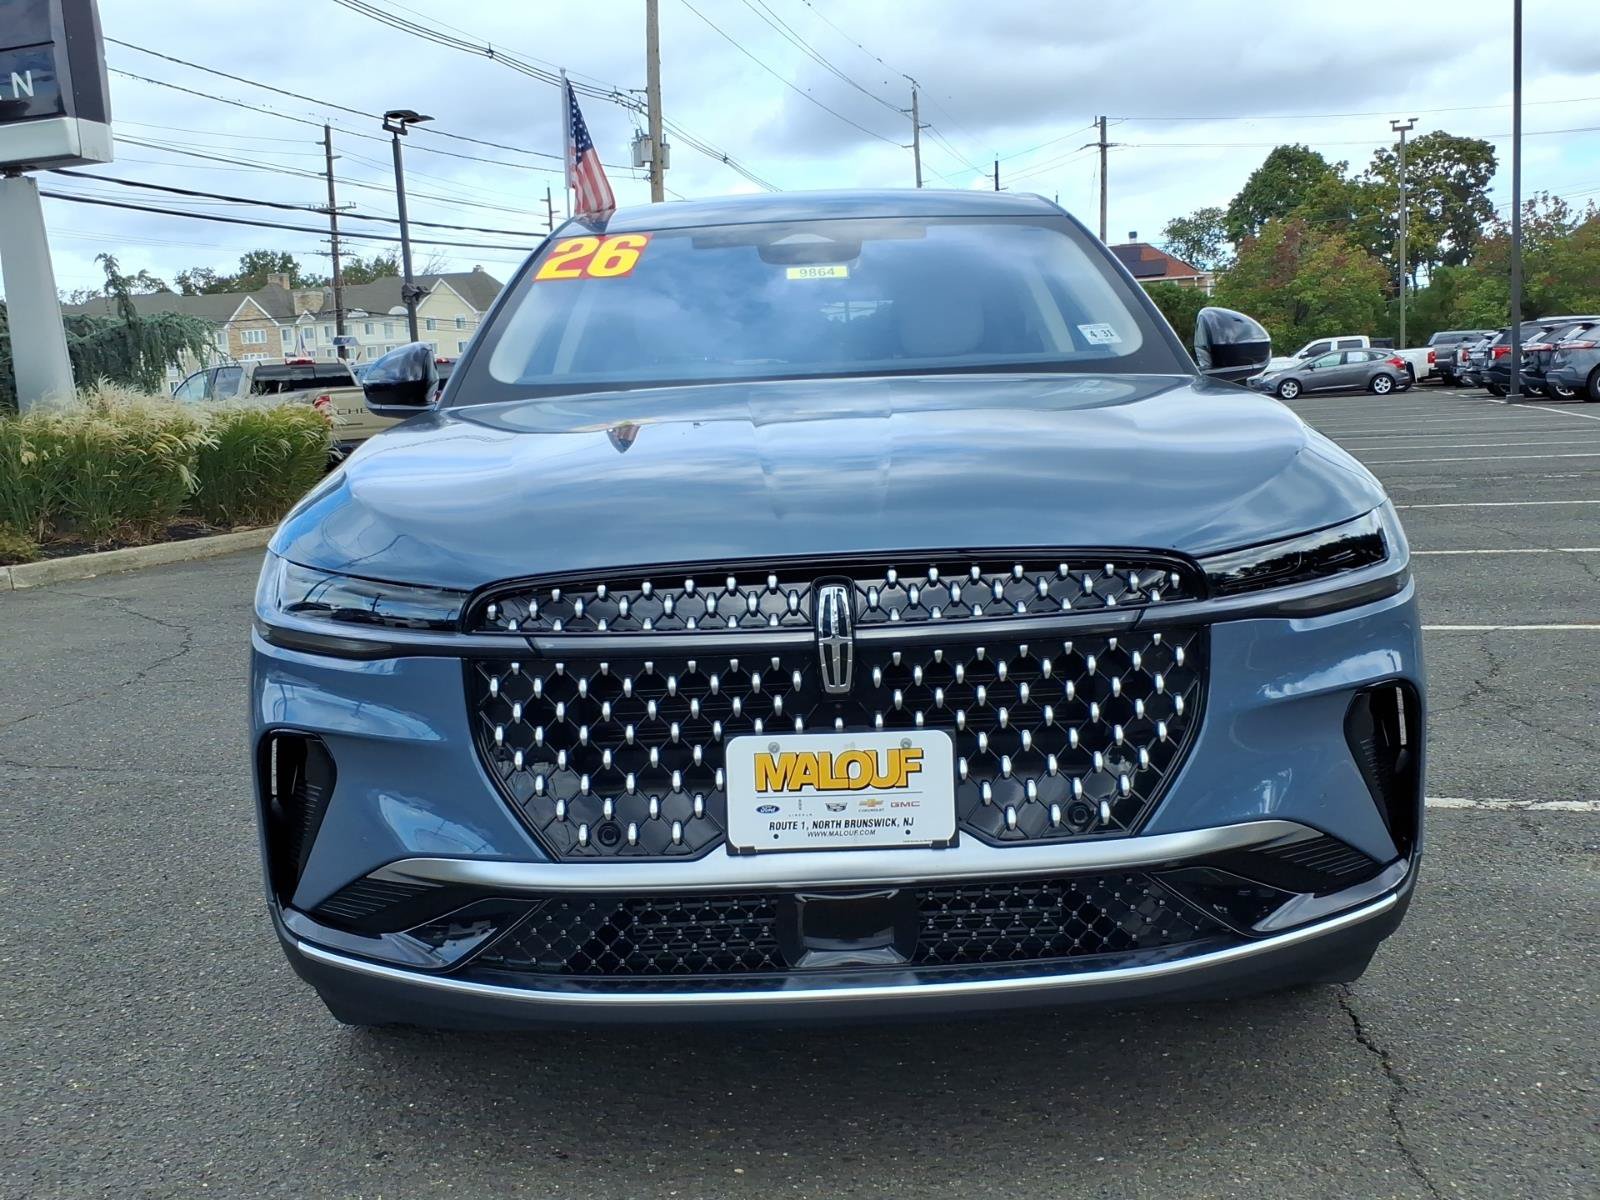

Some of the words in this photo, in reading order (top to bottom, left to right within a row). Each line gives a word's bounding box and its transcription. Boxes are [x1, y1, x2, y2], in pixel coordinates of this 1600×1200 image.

[0, 70, 34, 99] N
[535, 234, 648, 280] 26
[799, 267, 835, 278] 9864
[754, 748, 924, 793] MALOUF
[769, 821, 798, 831] ROUTE
[801, 821, 809, 831] 1,
[812, 819, 842, 829] NORTH
[844, 817, 900, 828] BRUNSWICK,
[903, 817, 914, 827] NJ
[807, 829, 876, 838] WWW.MALOUF.COM
